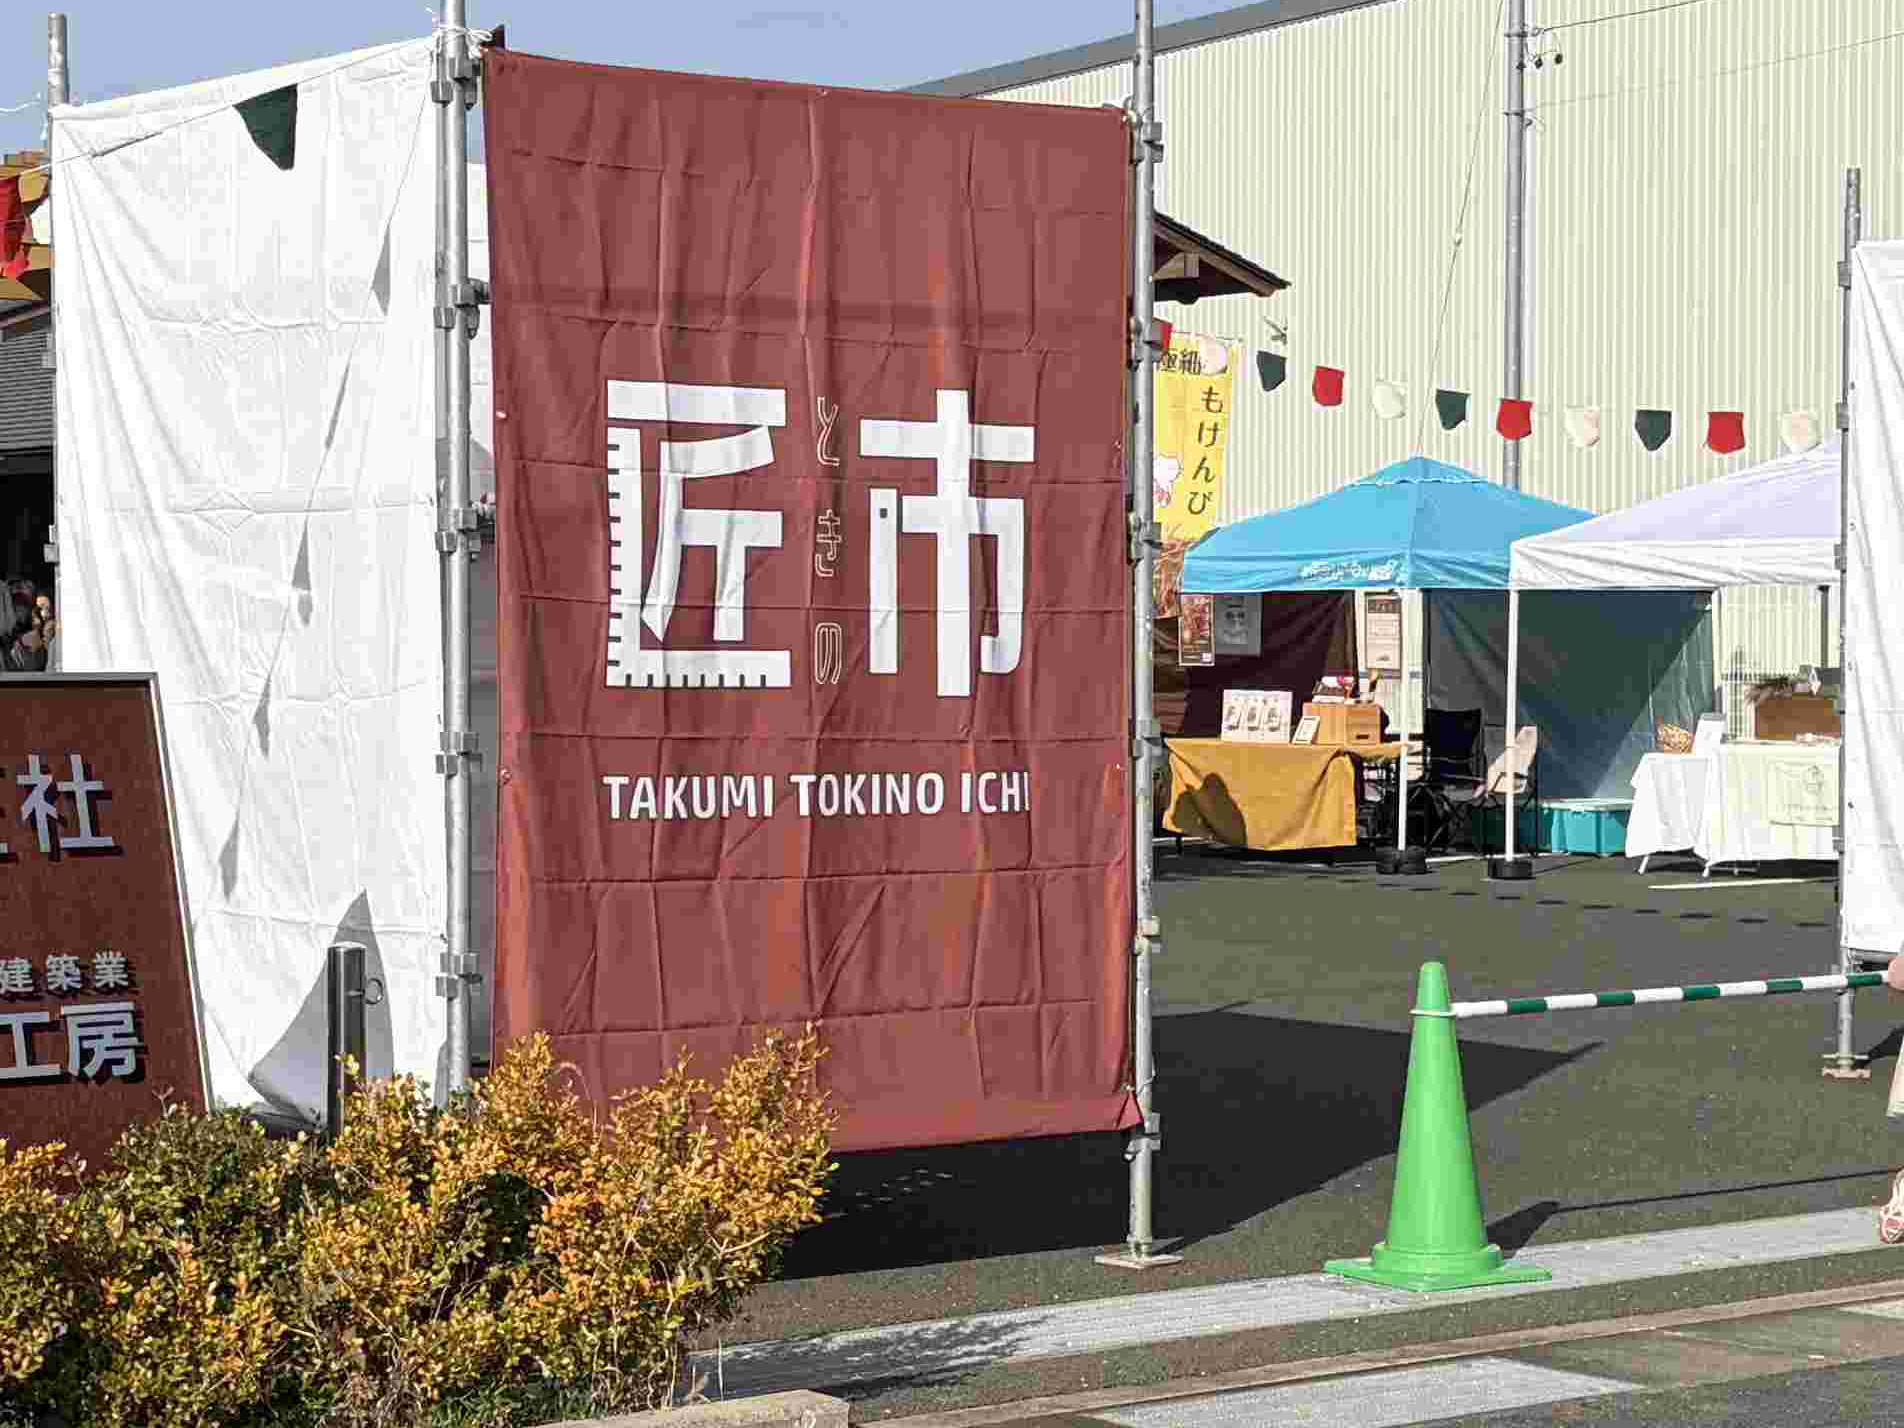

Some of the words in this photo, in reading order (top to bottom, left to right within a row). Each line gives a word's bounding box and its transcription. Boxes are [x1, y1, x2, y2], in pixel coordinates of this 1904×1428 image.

[603, 774, 774, 820] TAKUMI
[790, 772, 945, 817] TOKINO
[961, 771, 1030, 813] ICHI
